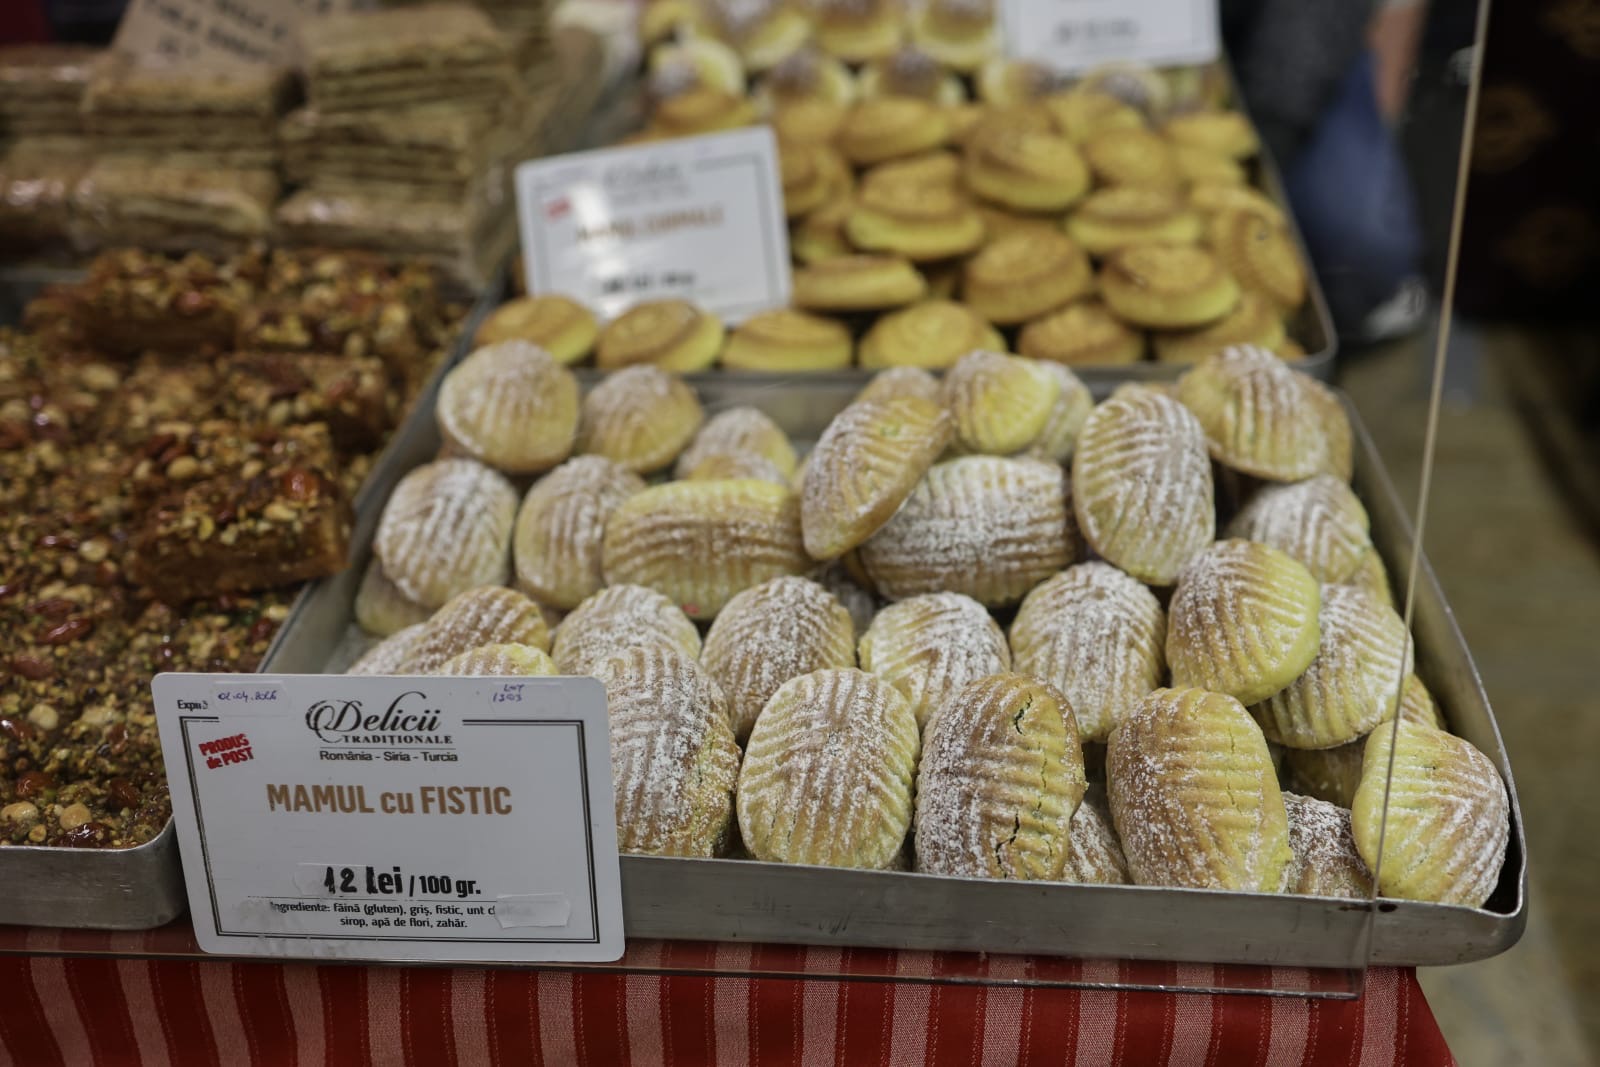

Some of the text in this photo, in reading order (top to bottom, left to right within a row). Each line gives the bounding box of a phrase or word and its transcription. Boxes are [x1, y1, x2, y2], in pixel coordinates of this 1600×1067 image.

[305, 691, 441, 743] Delicii
[198, 733, 250, 757] PRODUS
[206, 747, 254, 769] de POST
[319, 751, 373, 761] România
[384, 752, 410, 762] Siria
[420, 752, 458, 762] Turcia
[266, 783, 512, 815] MAMUL cu FISTIC
[456, 879, 481, 898] gr.
[333, 903, 360, 913] făină
[436, 905, 463, 915] fistic,
[467, 906, 485, 915] unt
[340, 916, 468, 928] sirop, apă de flori, zahăr.
